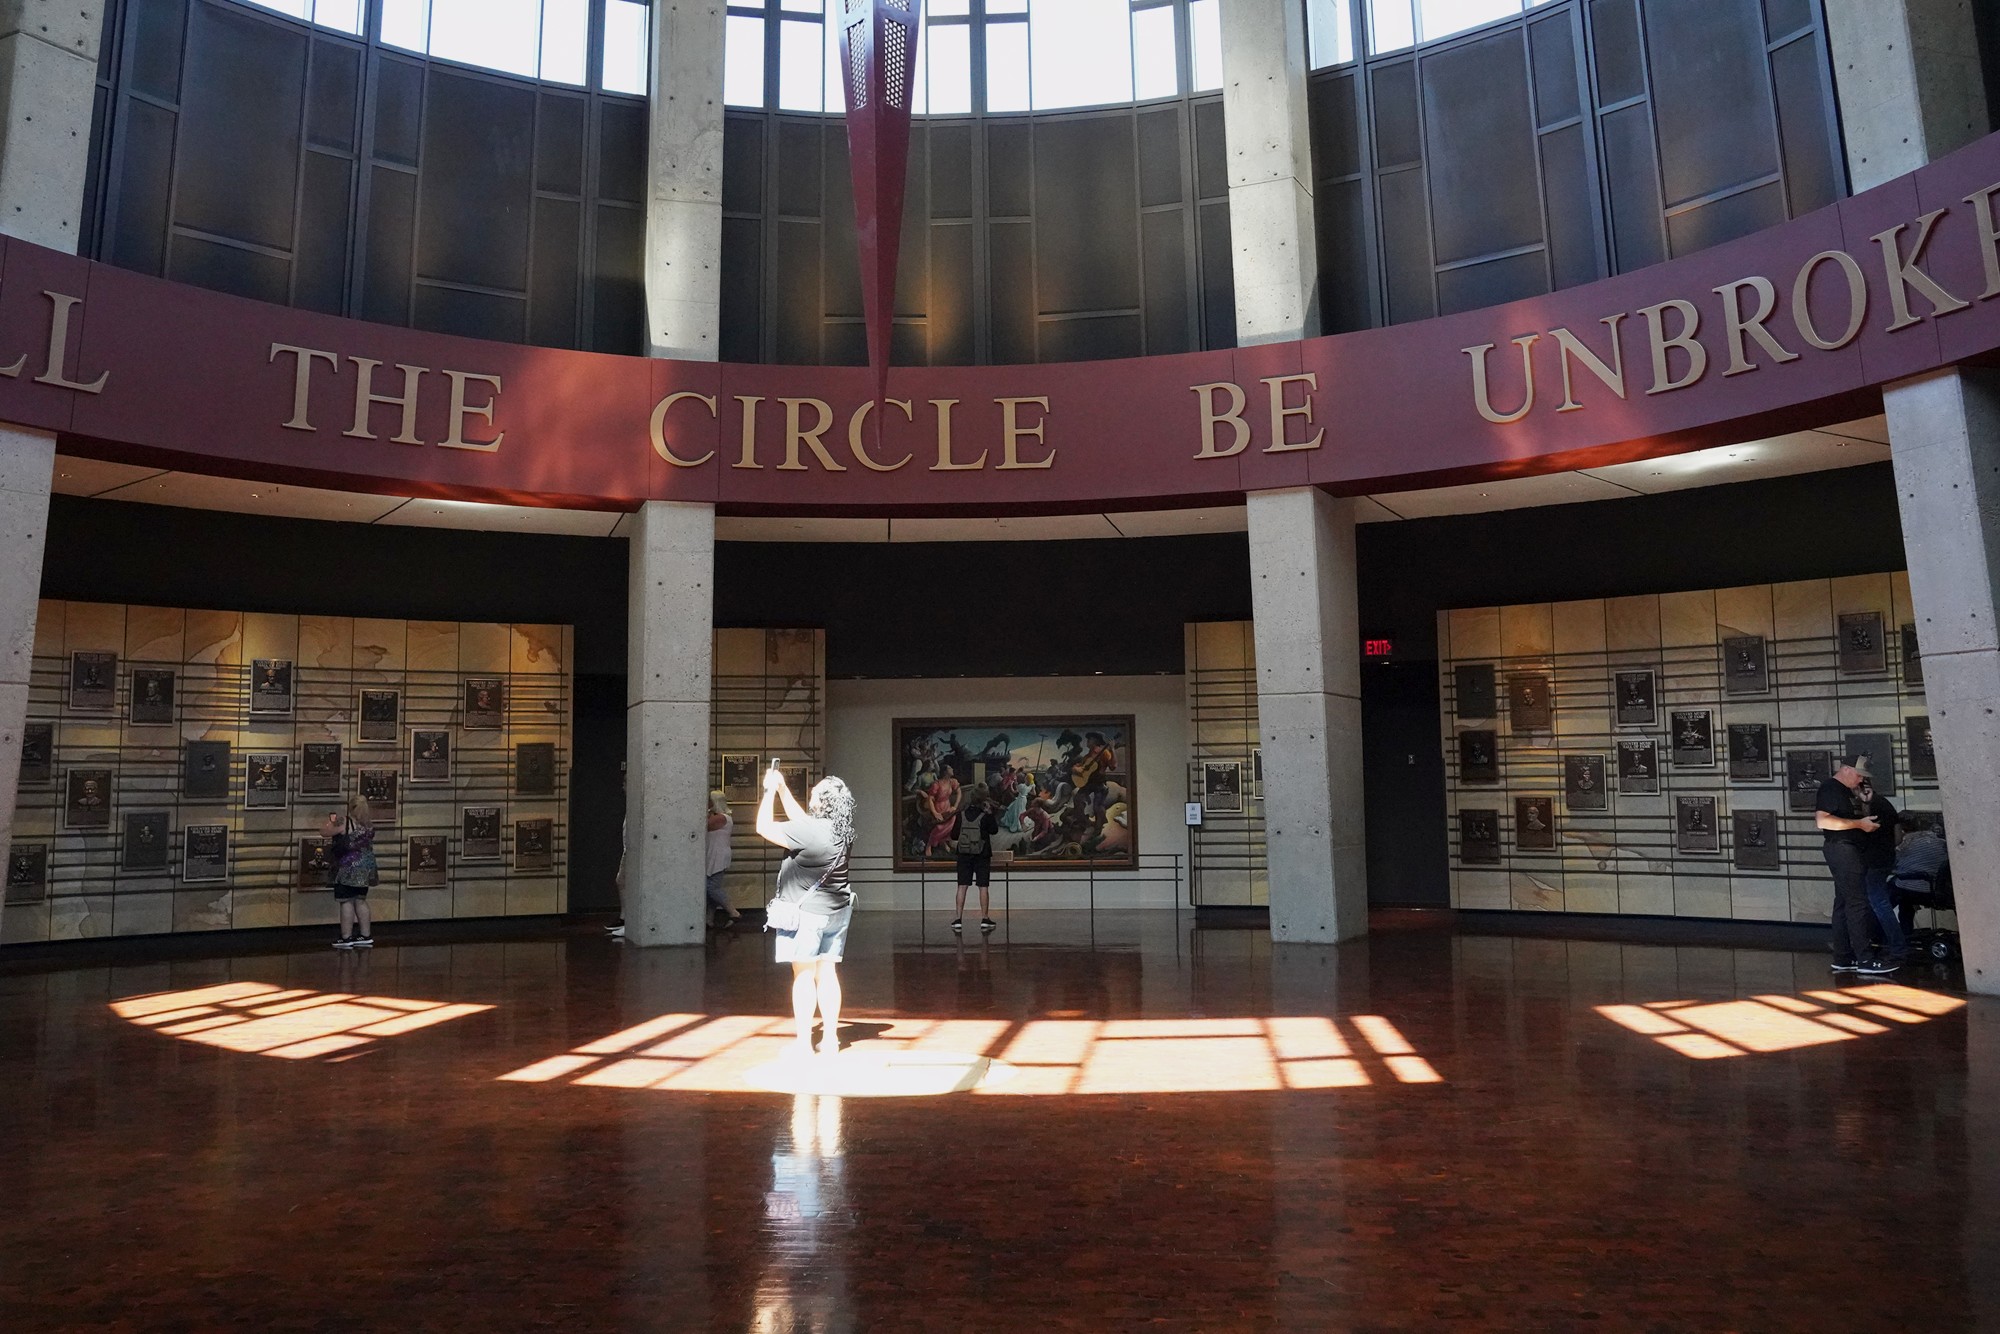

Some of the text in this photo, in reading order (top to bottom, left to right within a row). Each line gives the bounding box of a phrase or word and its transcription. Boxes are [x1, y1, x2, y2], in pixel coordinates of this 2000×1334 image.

[0, 290, 110, 394] L
[269, 342, 505, 453] THE
[649, 391, 1057, 472] CIRCLE
[1190, 373, 1325, 460] BE
[1366, 640, 1388, 655] EXIT
